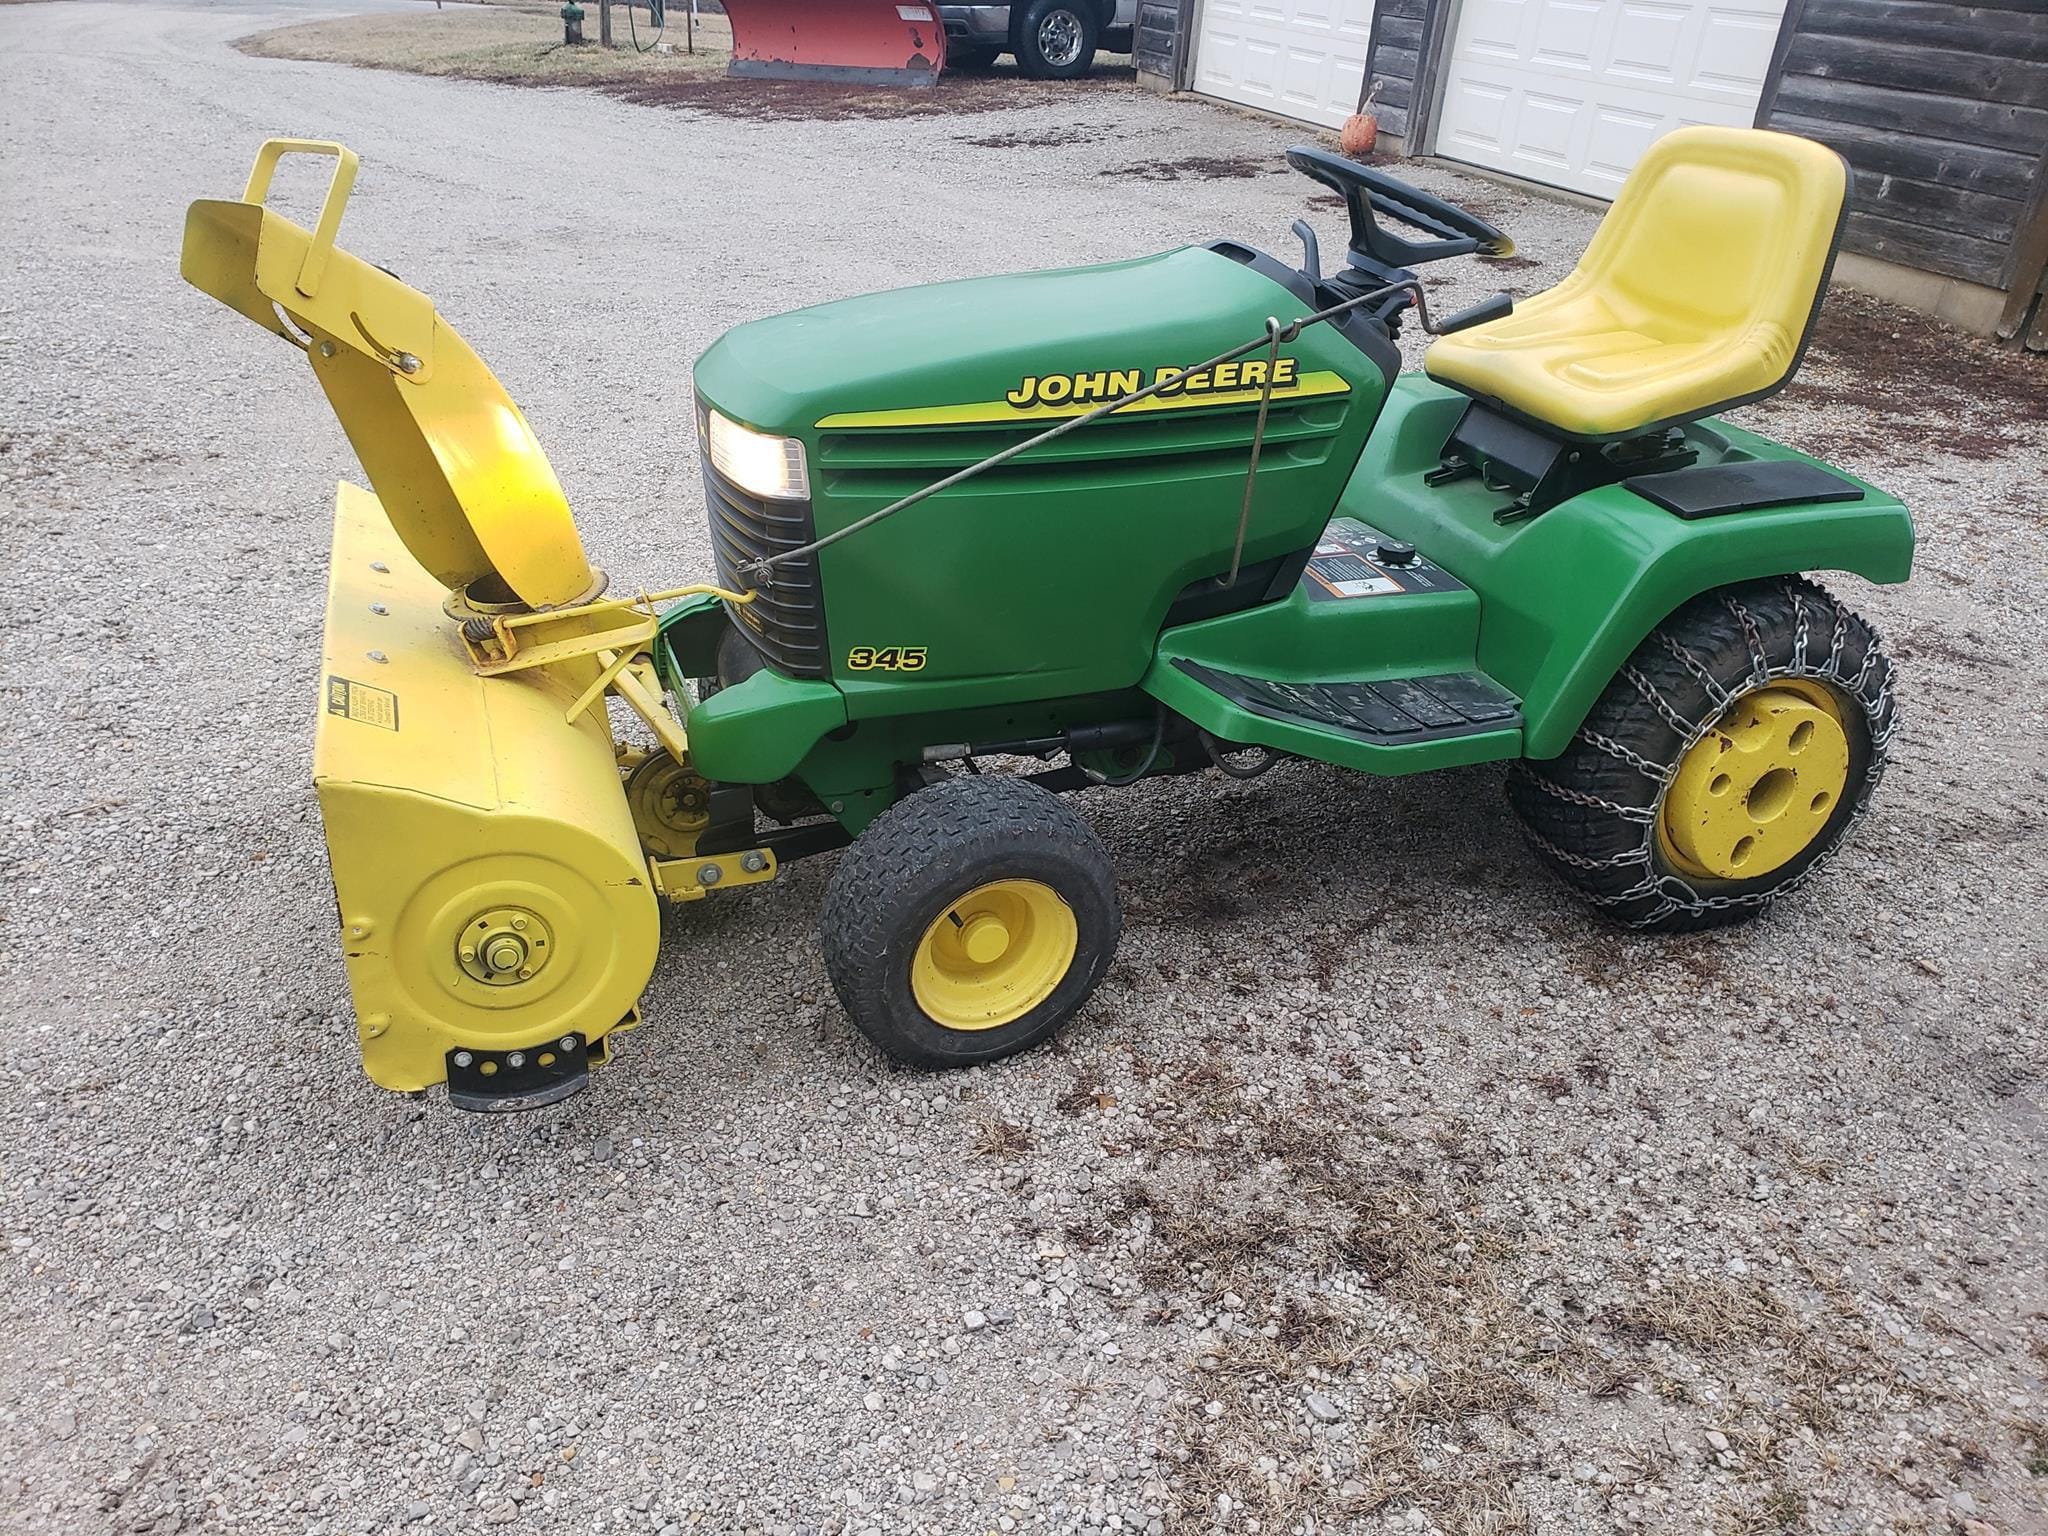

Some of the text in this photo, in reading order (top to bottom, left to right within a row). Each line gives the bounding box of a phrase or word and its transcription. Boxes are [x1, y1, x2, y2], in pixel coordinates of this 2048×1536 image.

[1006, 357, 1300, 405] JOHN DEERE
[847, 646, 928, 671] 345
